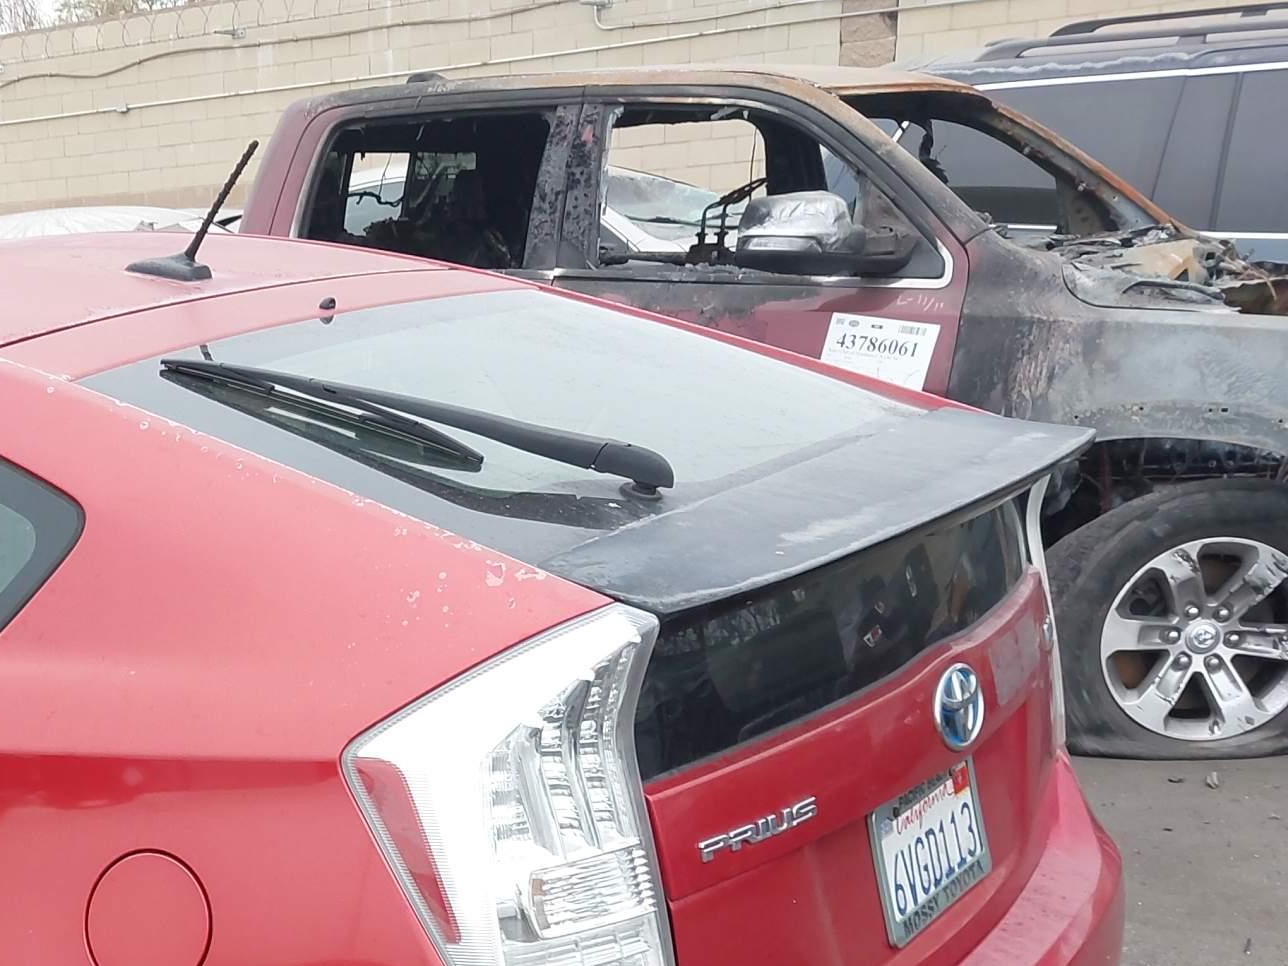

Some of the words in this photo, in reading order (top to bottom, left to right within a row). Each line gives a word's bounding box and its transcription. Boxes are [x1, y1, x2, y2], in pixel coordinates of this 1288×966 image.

[835, 332, 920, 358] 43786061
[698, 796, 817, 863] PRIUS
[894, 801, 977, 917] 6VGD113
